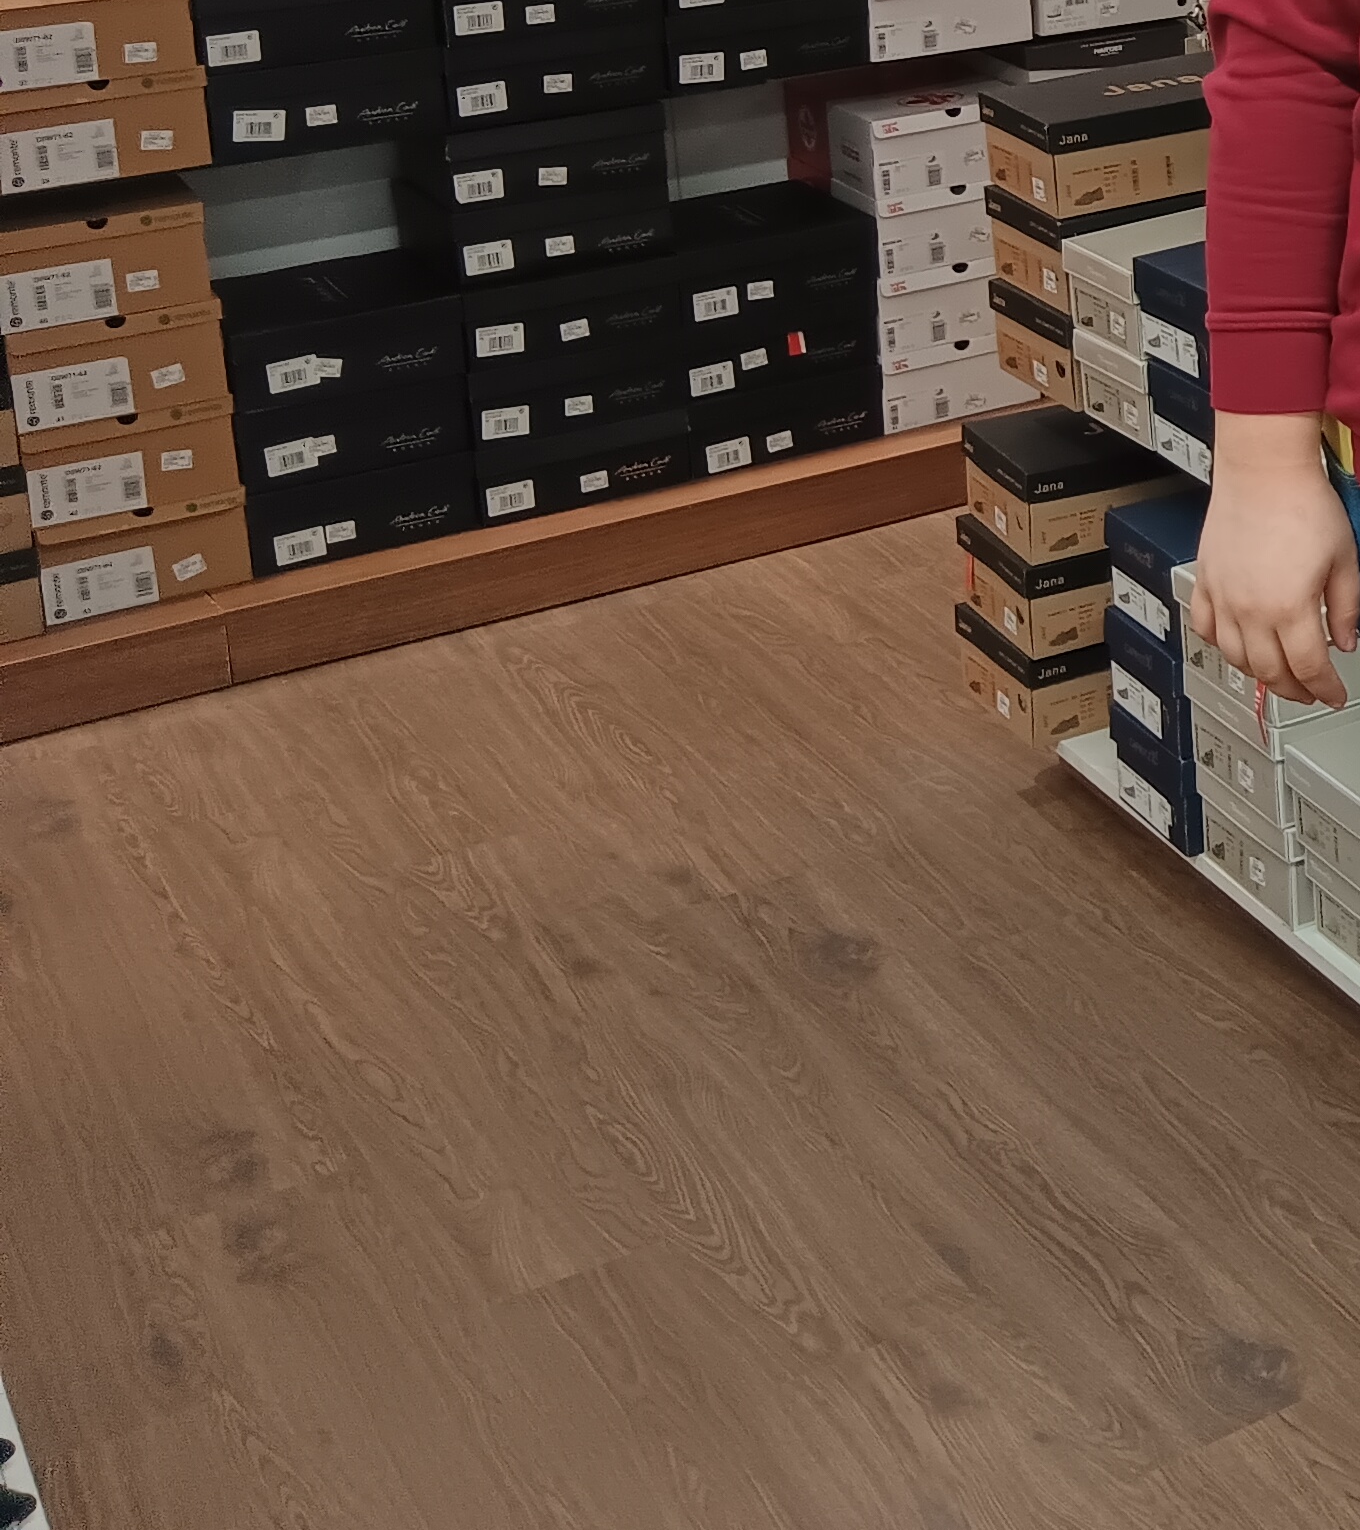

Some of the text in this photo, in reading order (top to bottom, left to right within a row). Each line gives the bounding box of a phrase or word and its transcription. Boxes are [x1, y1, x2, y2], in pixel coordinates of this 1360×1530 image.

[1103, 75, 1204, 96] Jana
[1059, 133, 1089, 145] Jana
[1034, 480, 1064, 494] Jana
[1035, 575, 1065, 589] Jana
[1038, 664, 1067, 679] Jana
